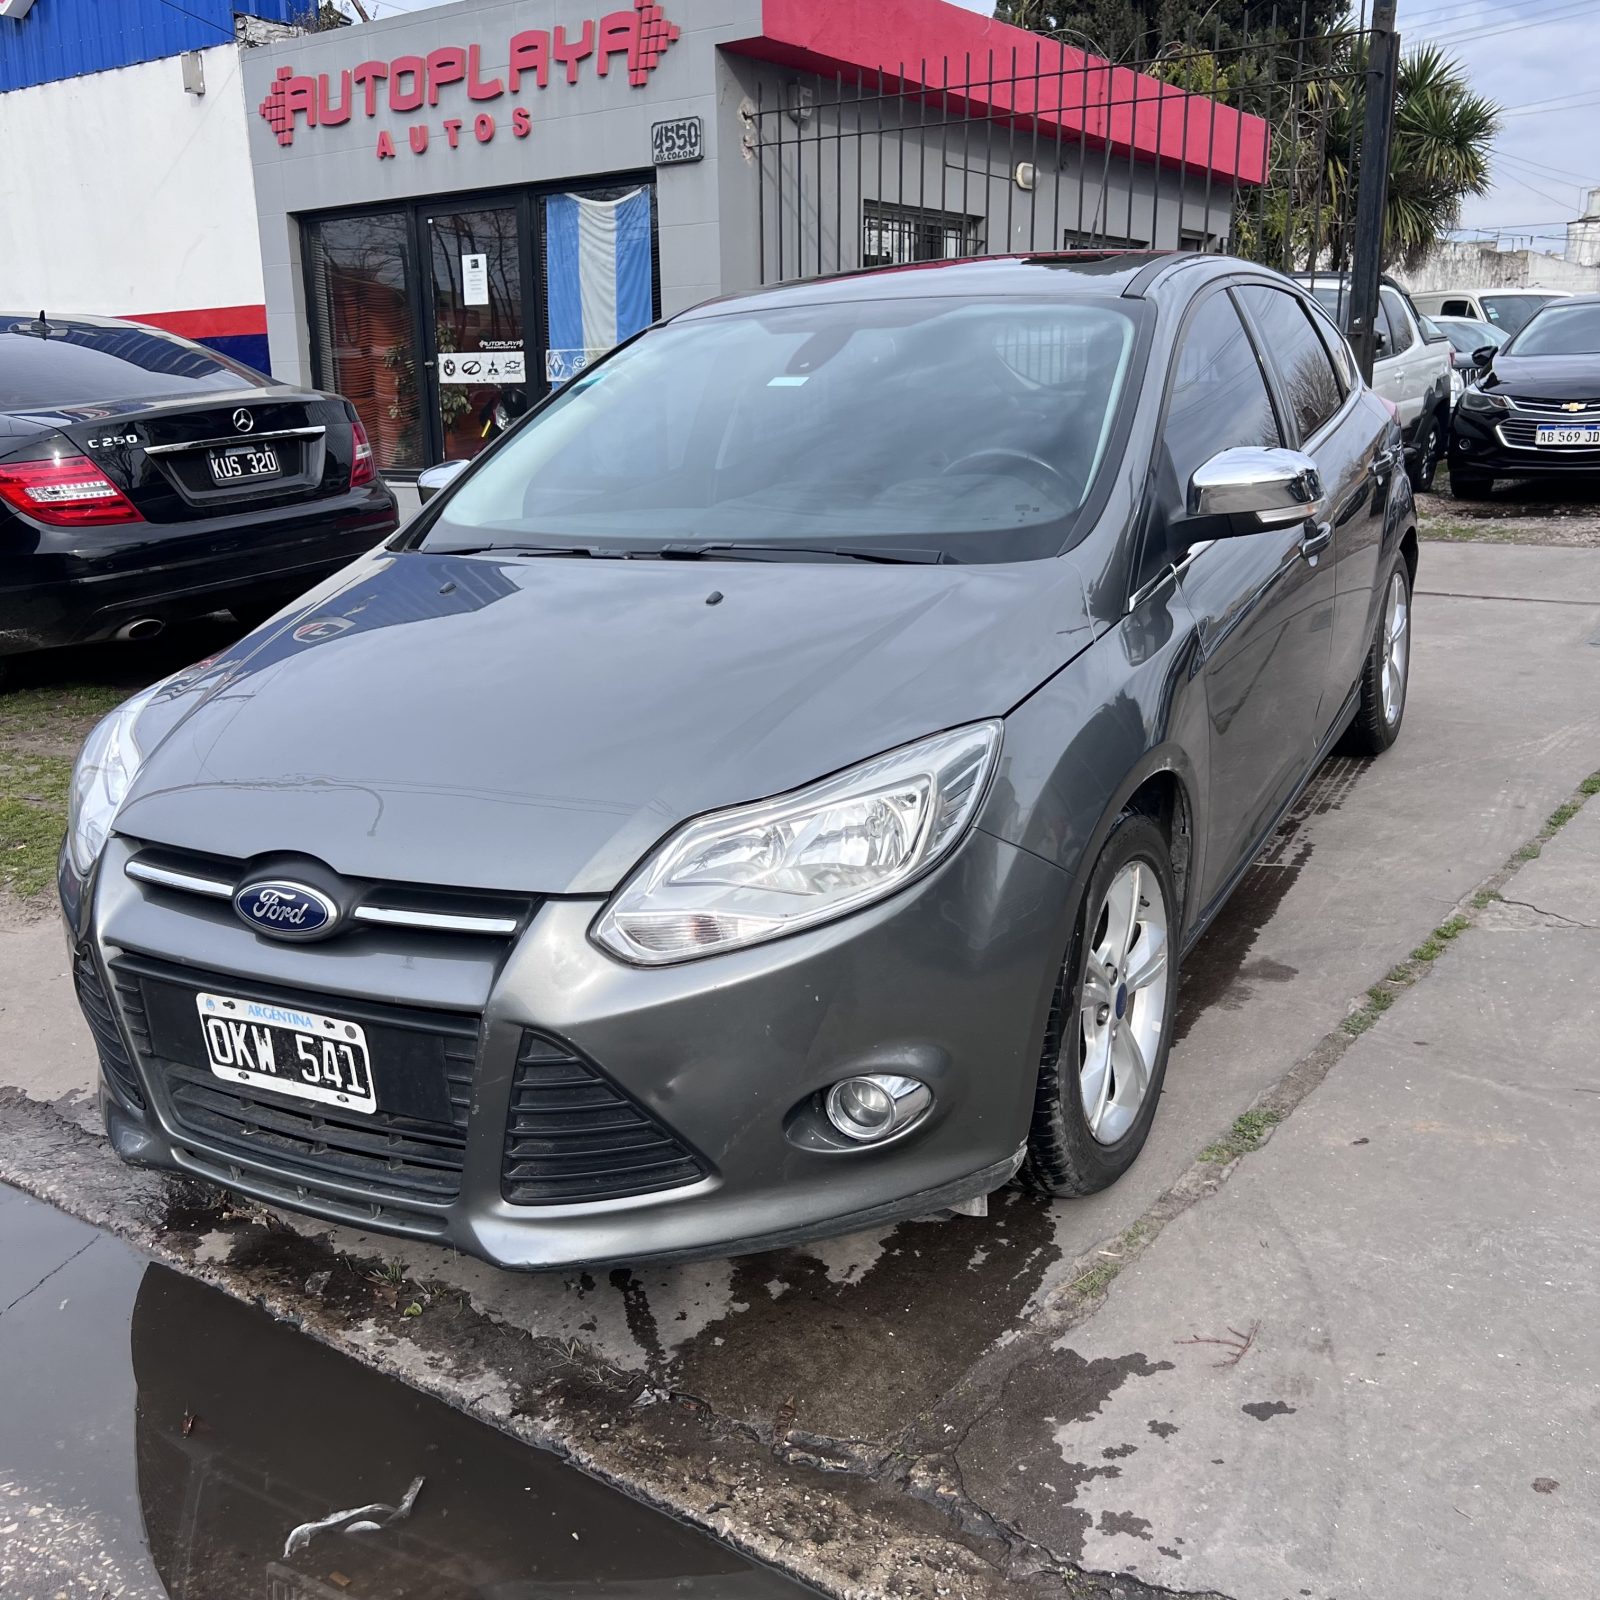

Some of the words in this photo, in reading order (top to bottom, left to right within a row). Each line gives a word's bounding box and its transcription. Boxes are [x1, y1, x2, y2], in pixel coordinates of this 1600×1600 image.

[284, 10, 642, 131] AUTOPLAYA
[376, 106, 532, 159] AUTOS
[654, 121, 698, 153] 4550
[88, 439, 98, 449] C
[102, 434, 138, 447] 250
[1540, 432, 1554, 442] AB
[1558, 432, 1581, 442] 569
[1585, 432, 1600, 442] JD
[210, 456, 242, 479] KUS
[246, 451, 277, 474] 320
[253, 889, 309, 924] Ford
[248, 1004, 314, 1028] ARGENTINA
[207, 1018, 277, 1073] OKW
[295, 1033, 366, 1095] 541
